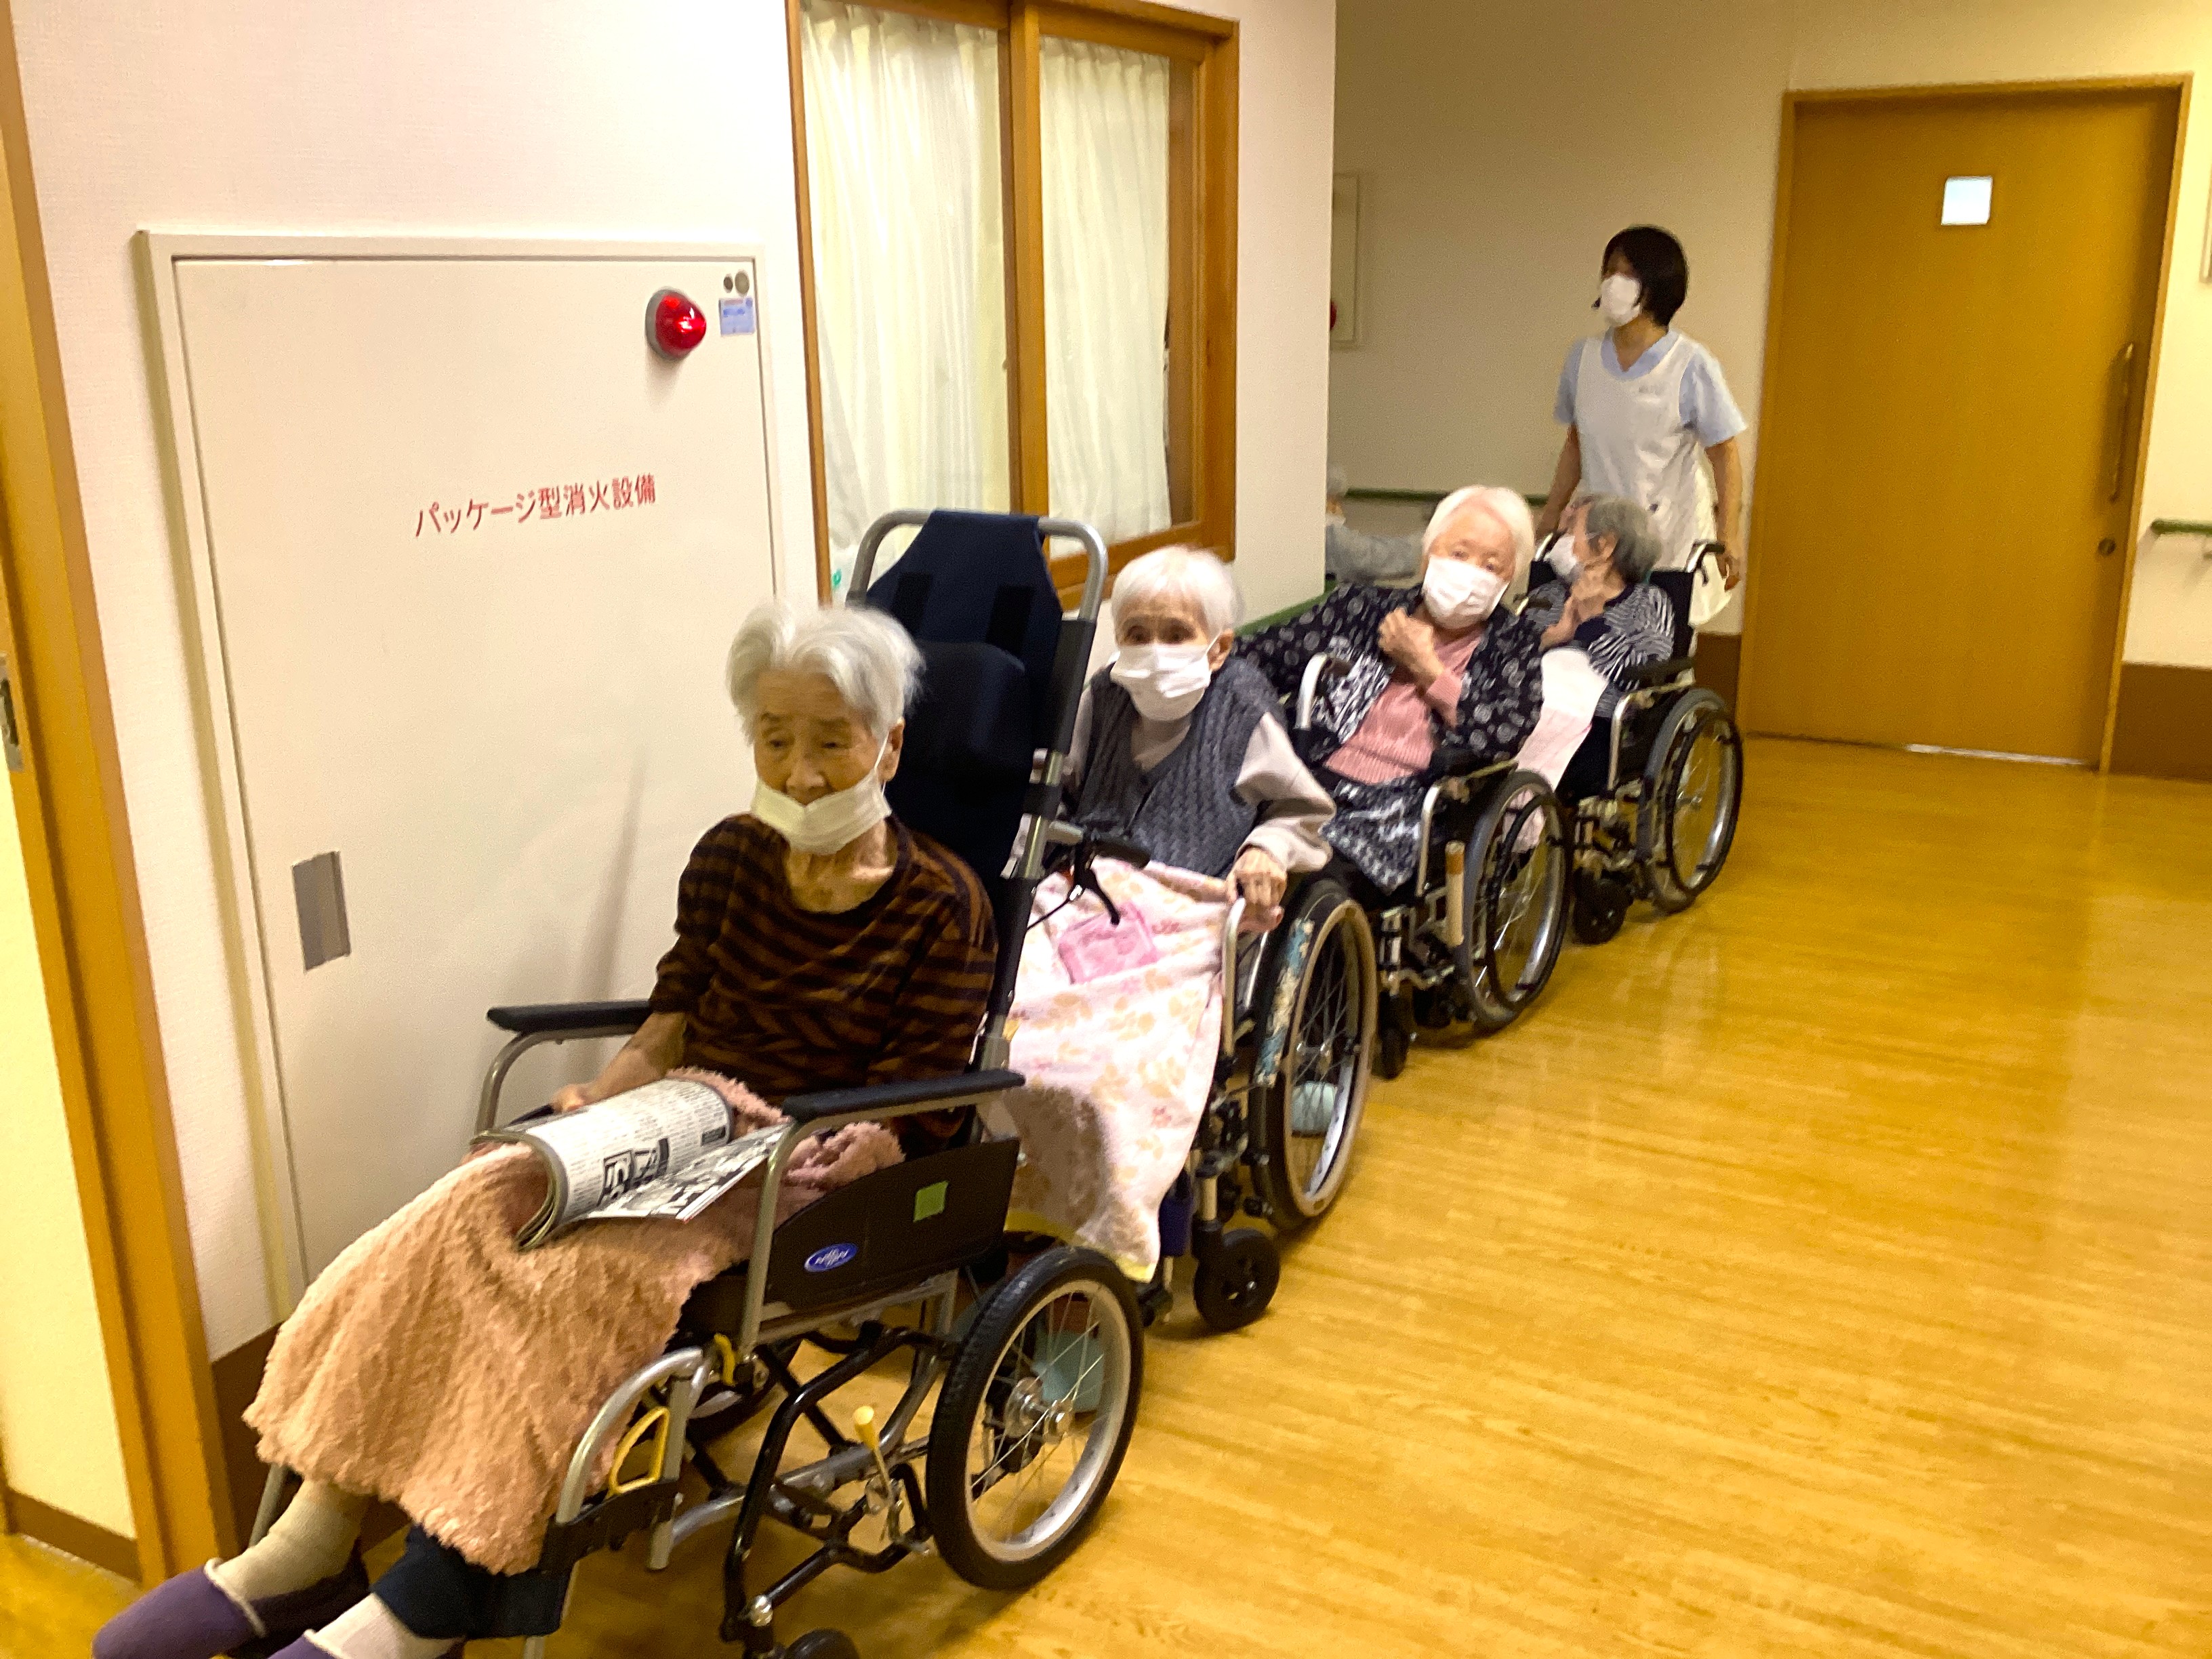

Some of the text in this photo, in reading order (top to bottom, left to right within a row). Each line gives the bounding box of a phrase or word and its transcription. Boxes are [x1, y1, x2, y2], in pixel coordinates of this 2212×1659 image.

[415, 472, 655, 537] パッケージ型消火設備
